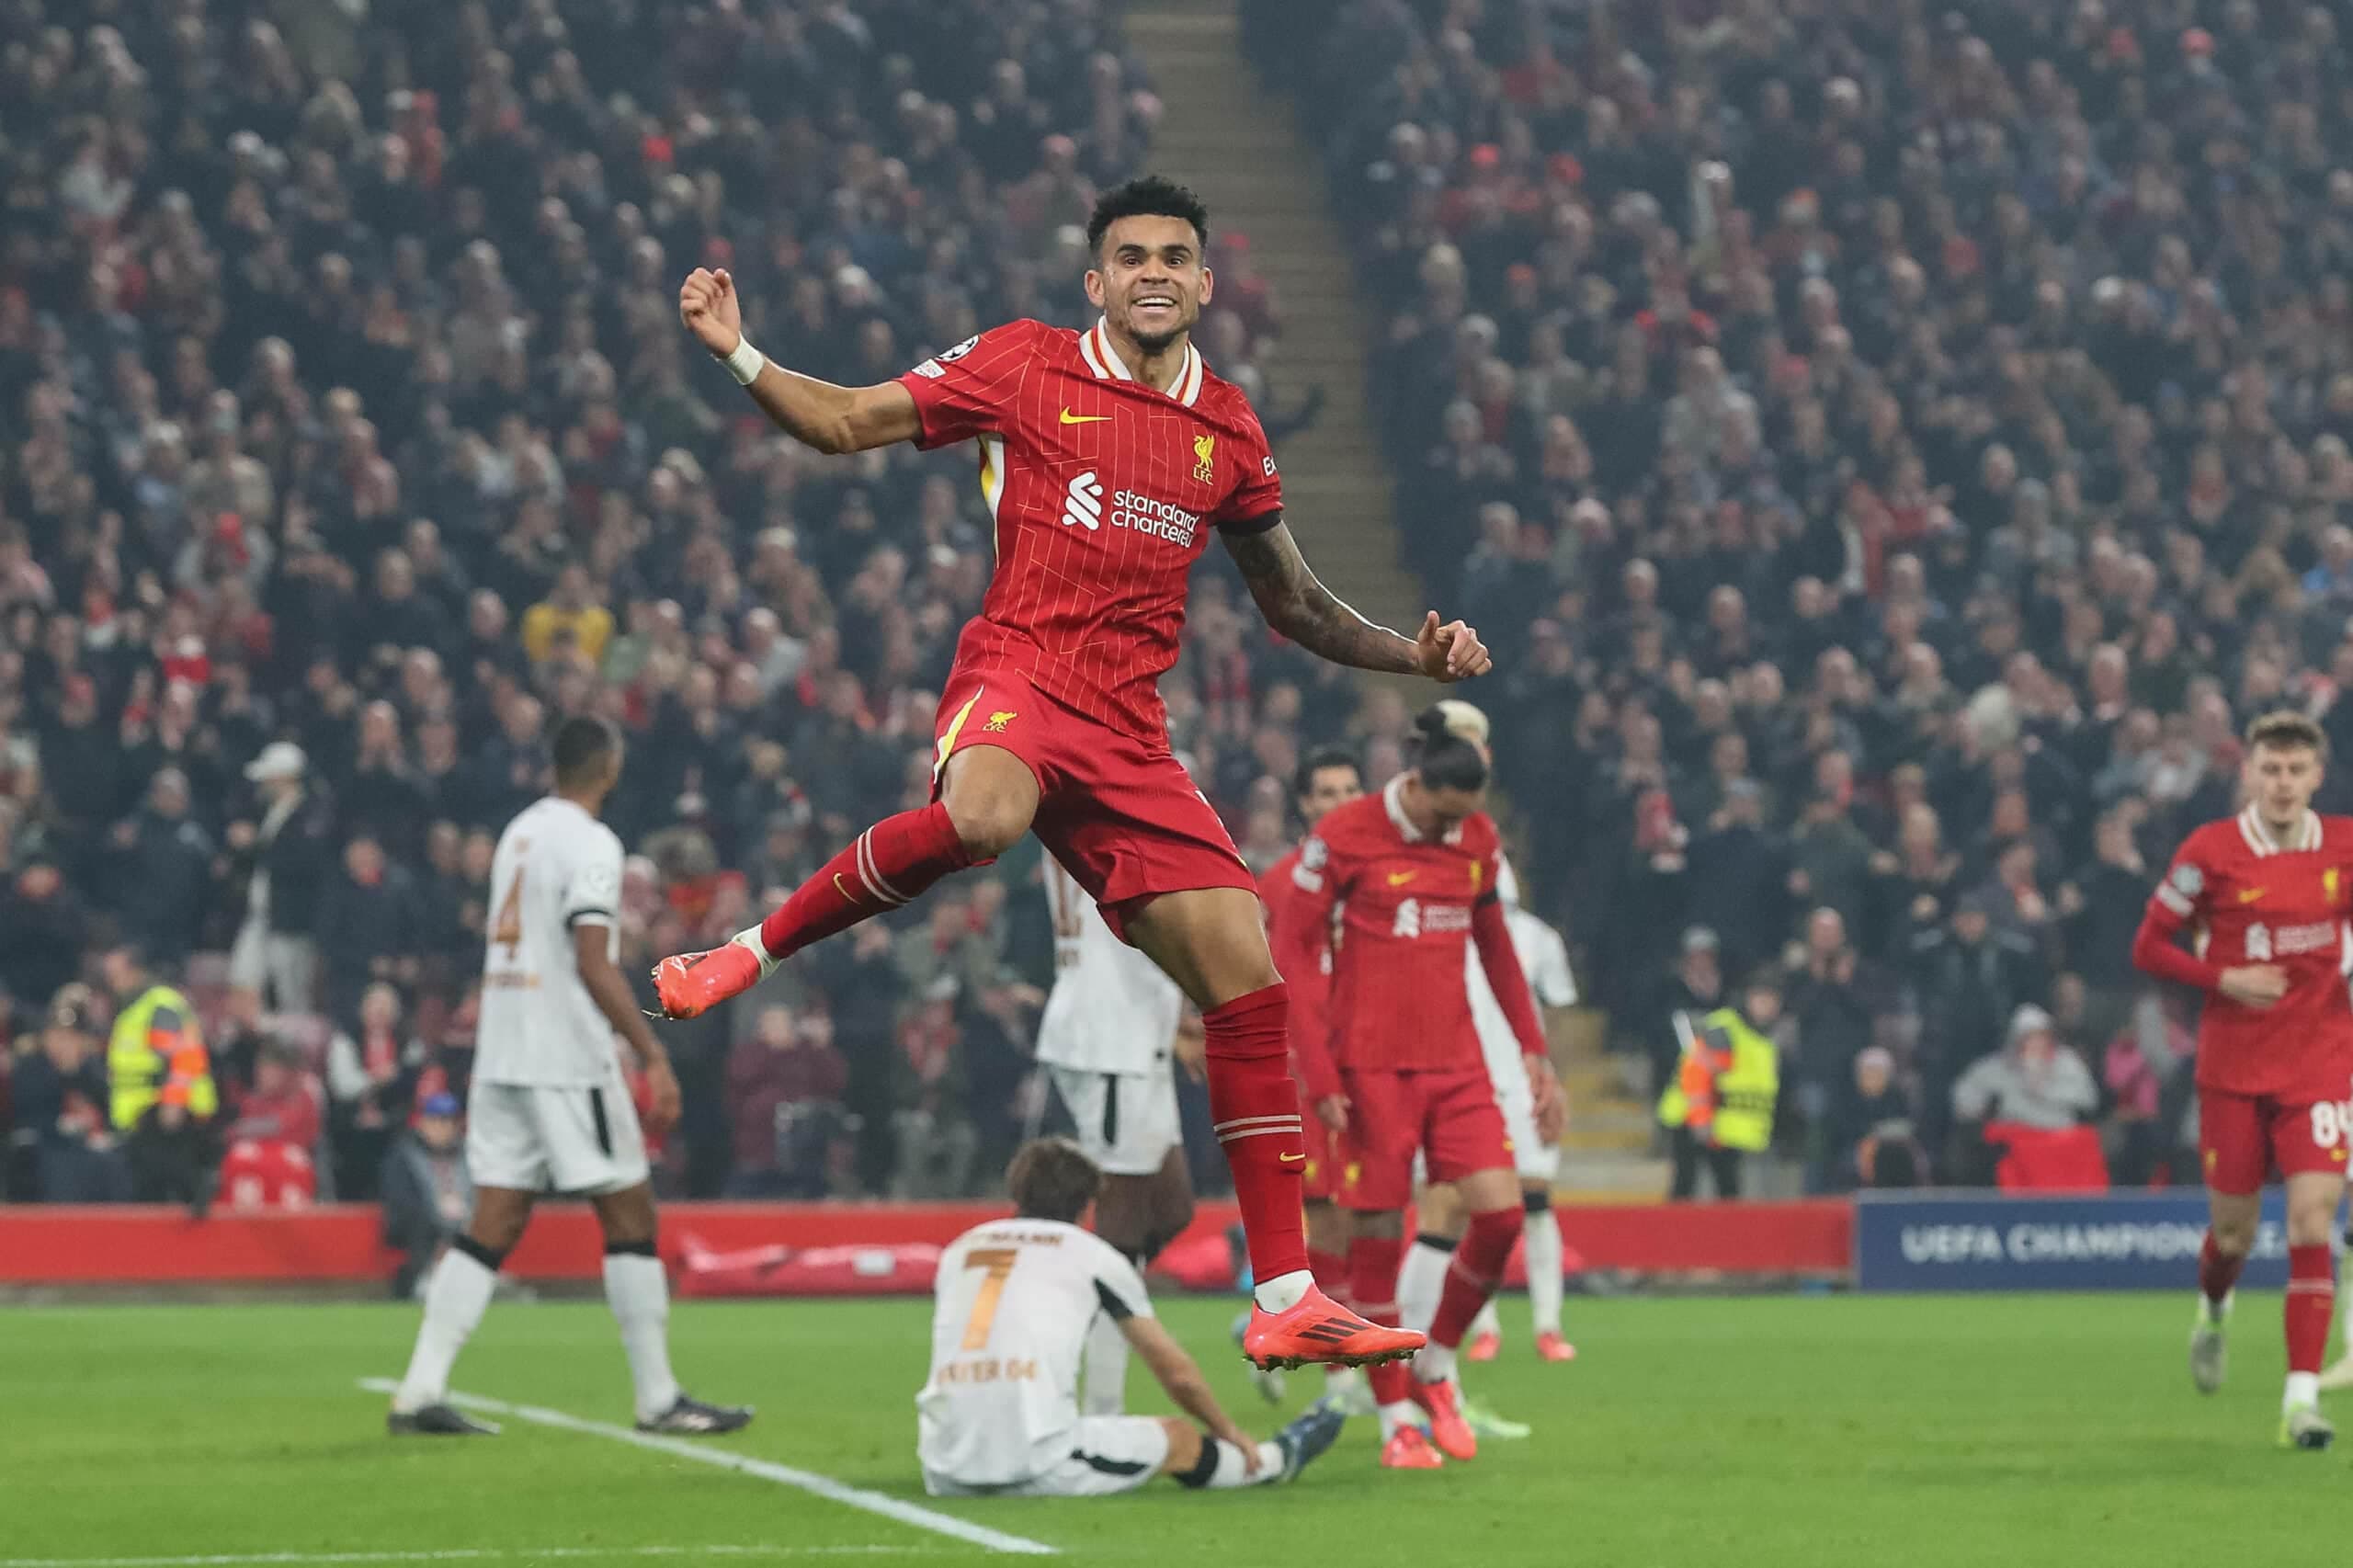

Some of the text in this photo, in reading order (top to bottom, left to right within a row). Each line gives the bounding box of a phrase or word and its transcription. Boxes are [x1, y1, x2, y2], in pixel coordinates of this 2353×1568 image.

[1193, 467, 1213, 485] LFC
[1113, 489, 1199, 533] standard
[493, 865, 523, 962] 4
[1901, 1223, 2004, 1264] UEFA
[2006, 1221, 2206, 1263] CHAMPION
[961, 1248, 1018, 1352] 7
